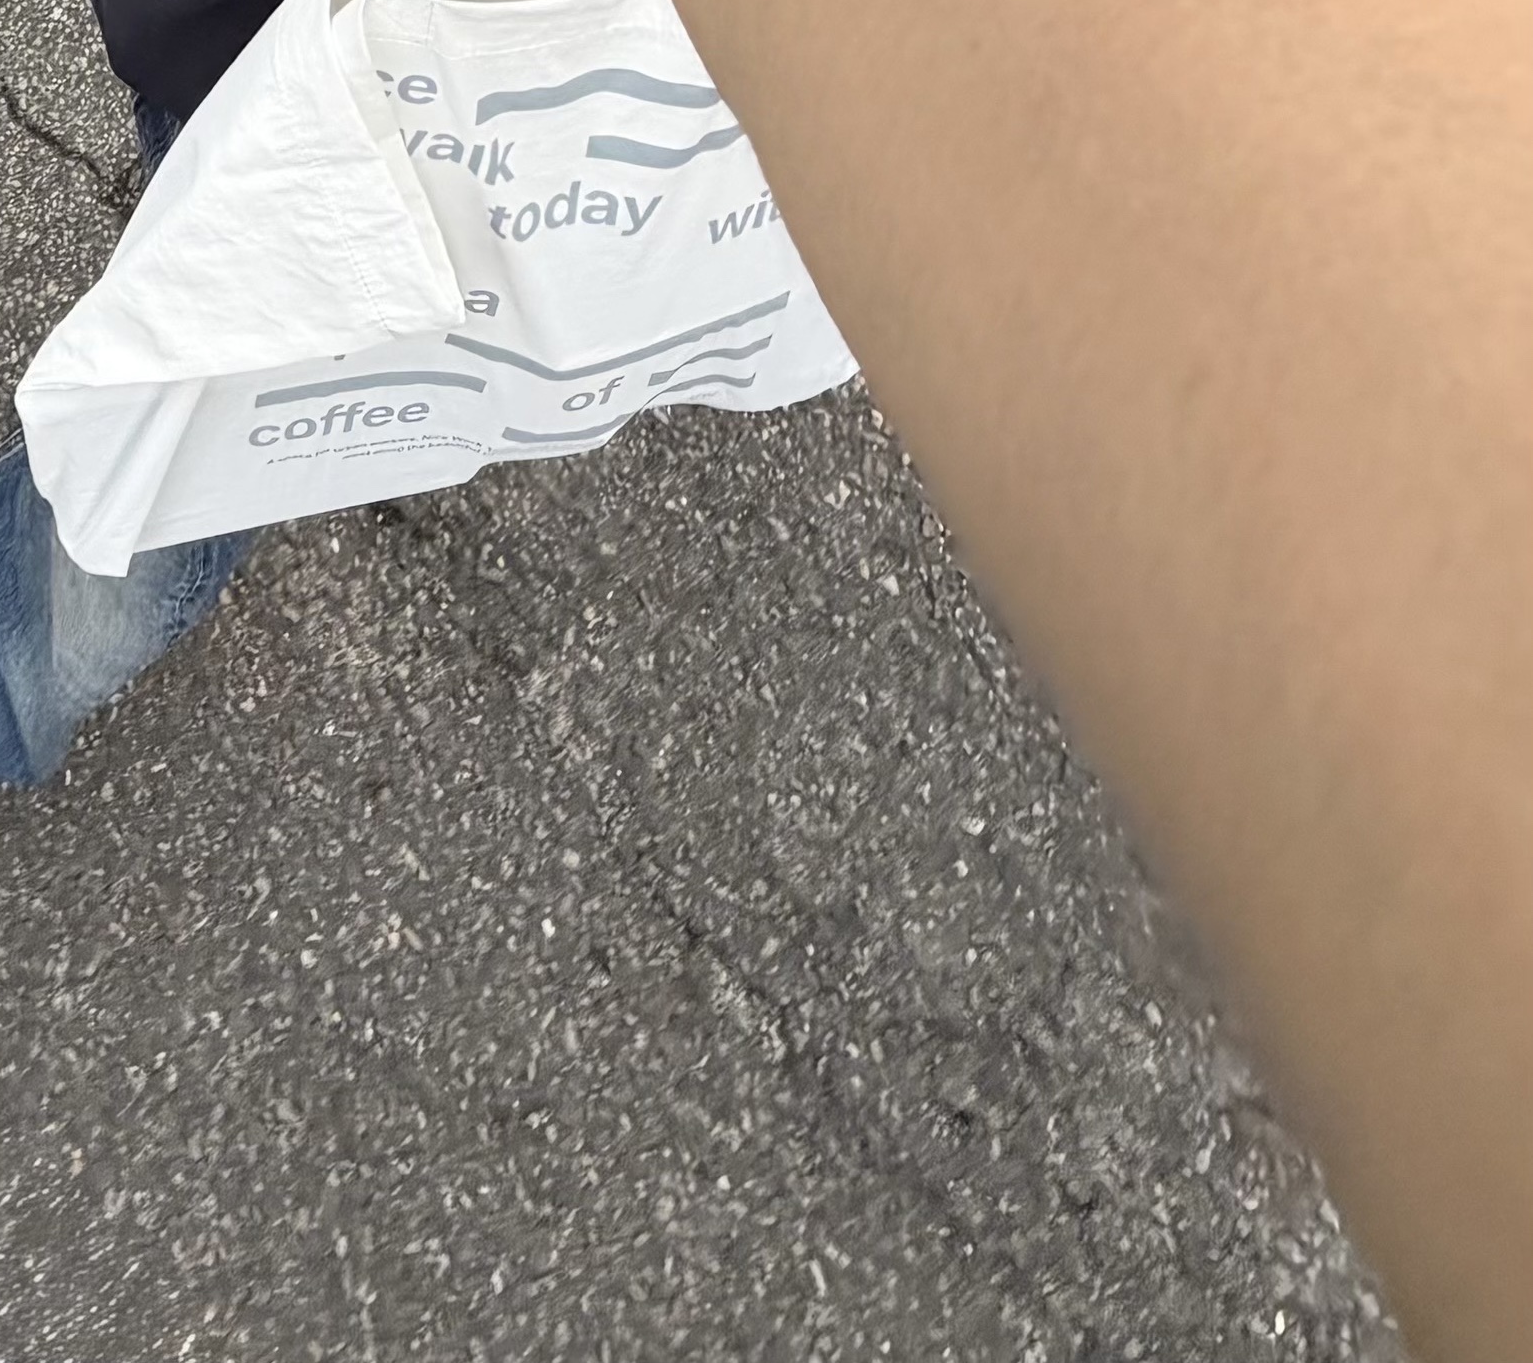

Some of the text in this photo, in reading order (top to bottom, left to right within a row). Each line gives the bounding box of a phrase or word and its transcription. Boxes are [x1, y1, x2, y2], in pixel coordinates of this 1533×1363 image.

[488, 180, 663, 243] today
[464, 289, 500, 317] a
[562, 375, 625, 412] of
[247, 401, 430, 448] coffee
